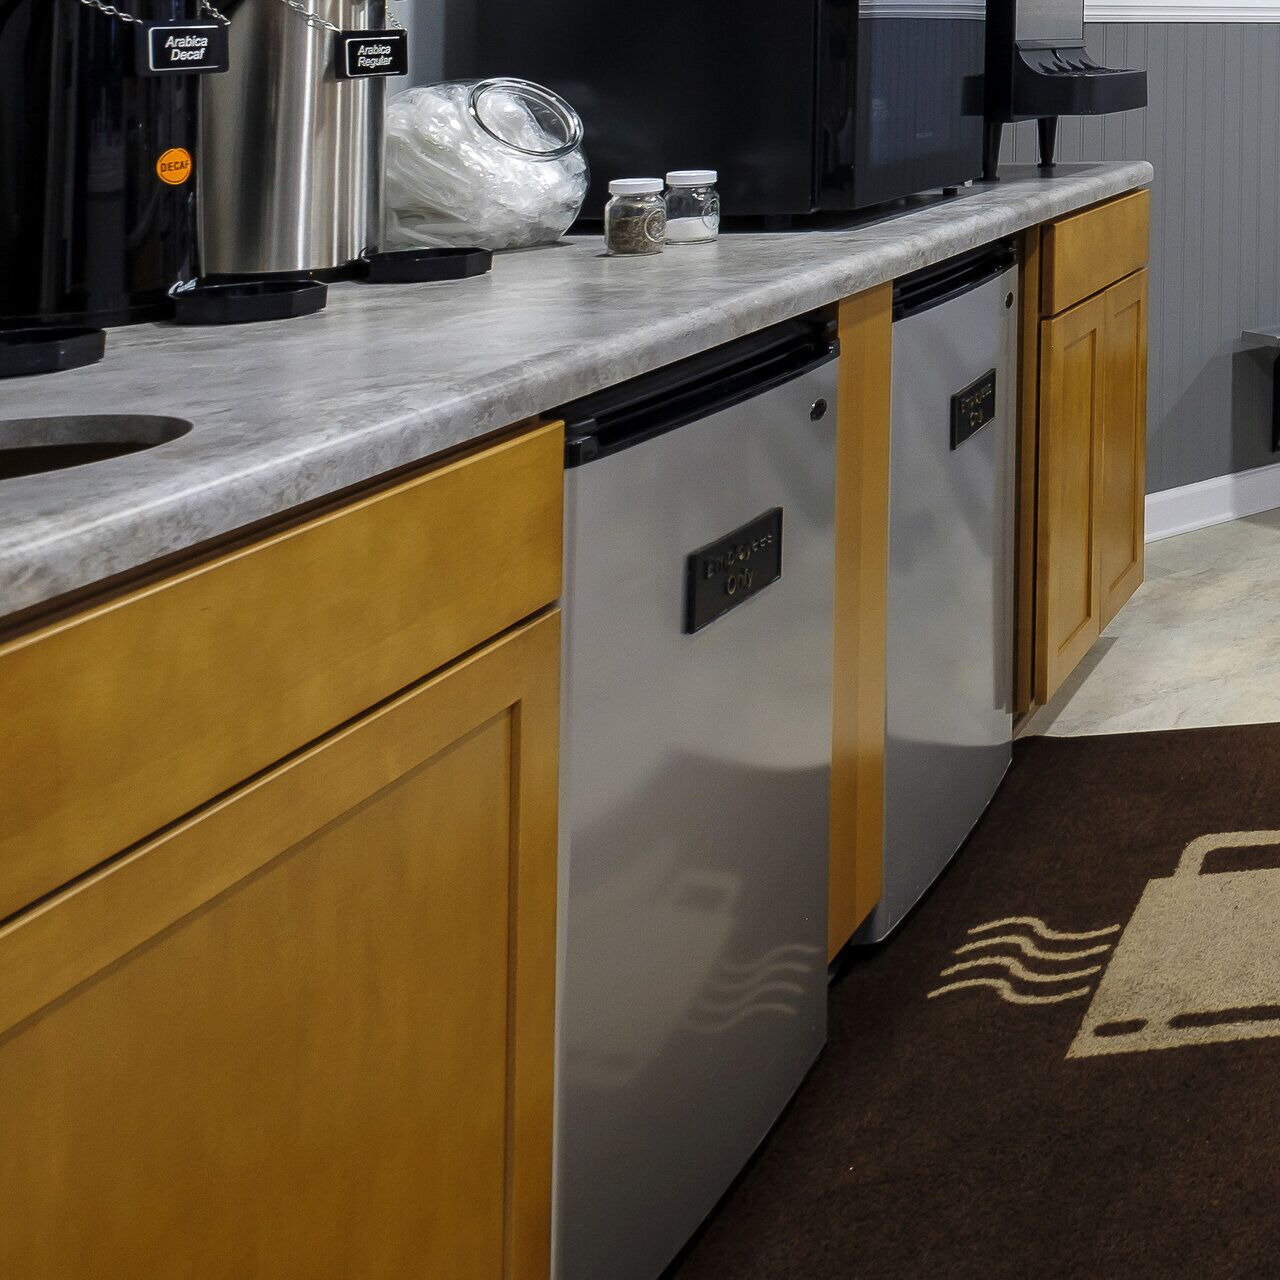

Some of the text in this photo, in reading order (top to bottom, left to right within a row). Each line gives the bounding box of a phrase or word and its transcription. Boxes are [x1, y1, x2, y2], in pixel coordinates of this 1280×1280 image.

[165, 35, 209, 49] Arabica
[170, 48, 206, 61] Decaf
[357, 44, 392, 56] Arabica
[358, 55, 393, 68] Regular
[160, 159, 190, 173] DECAF
